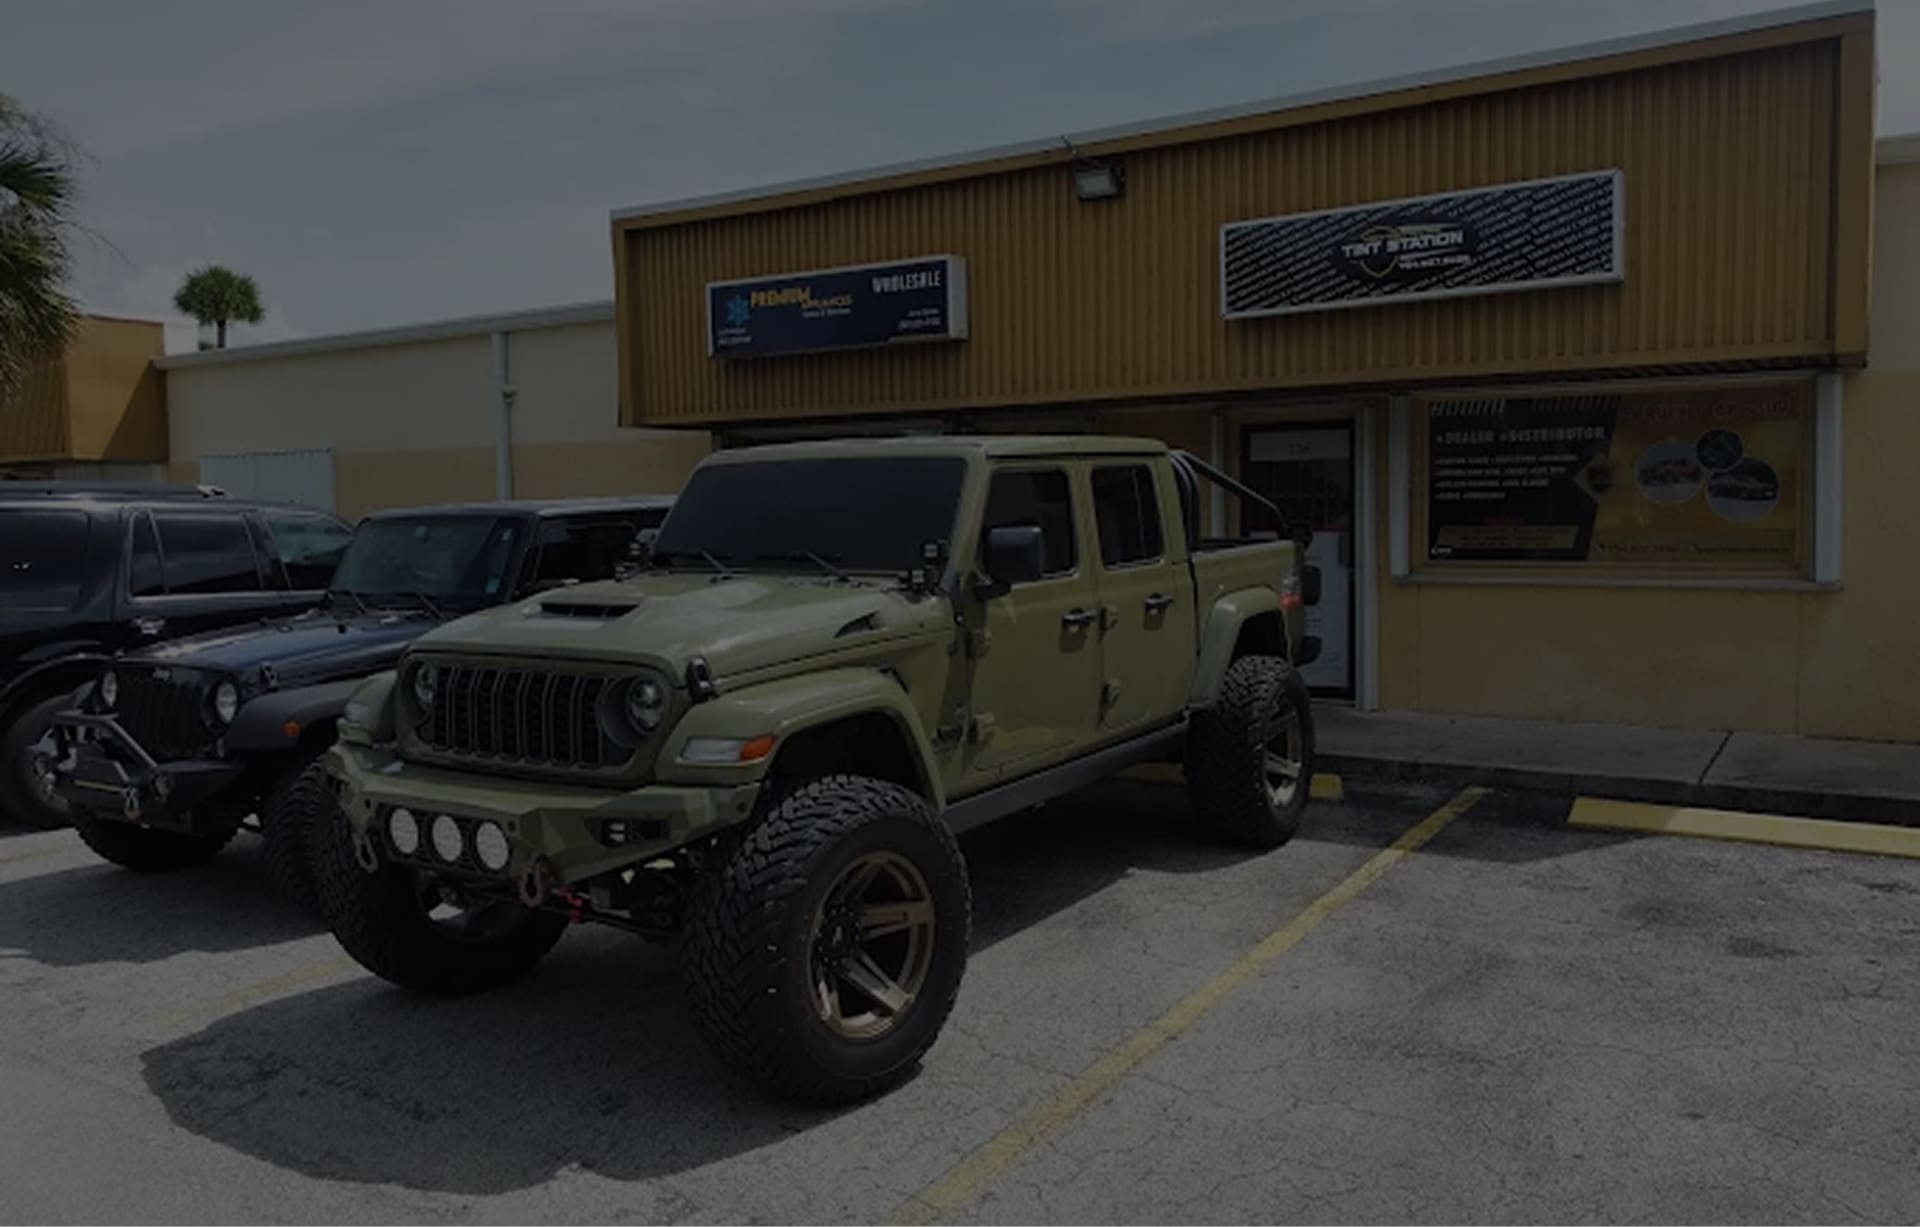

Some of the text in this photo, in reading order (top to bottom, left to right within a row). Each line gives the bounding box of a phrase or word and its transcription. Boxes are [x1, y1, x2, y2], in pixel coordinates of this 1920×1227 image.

[1386, 230, 1464, 253] STATION
[872, 271, 941, 293] WHOLESALE
[1508, 426, 1605, 442] DISTRIBUTOR
